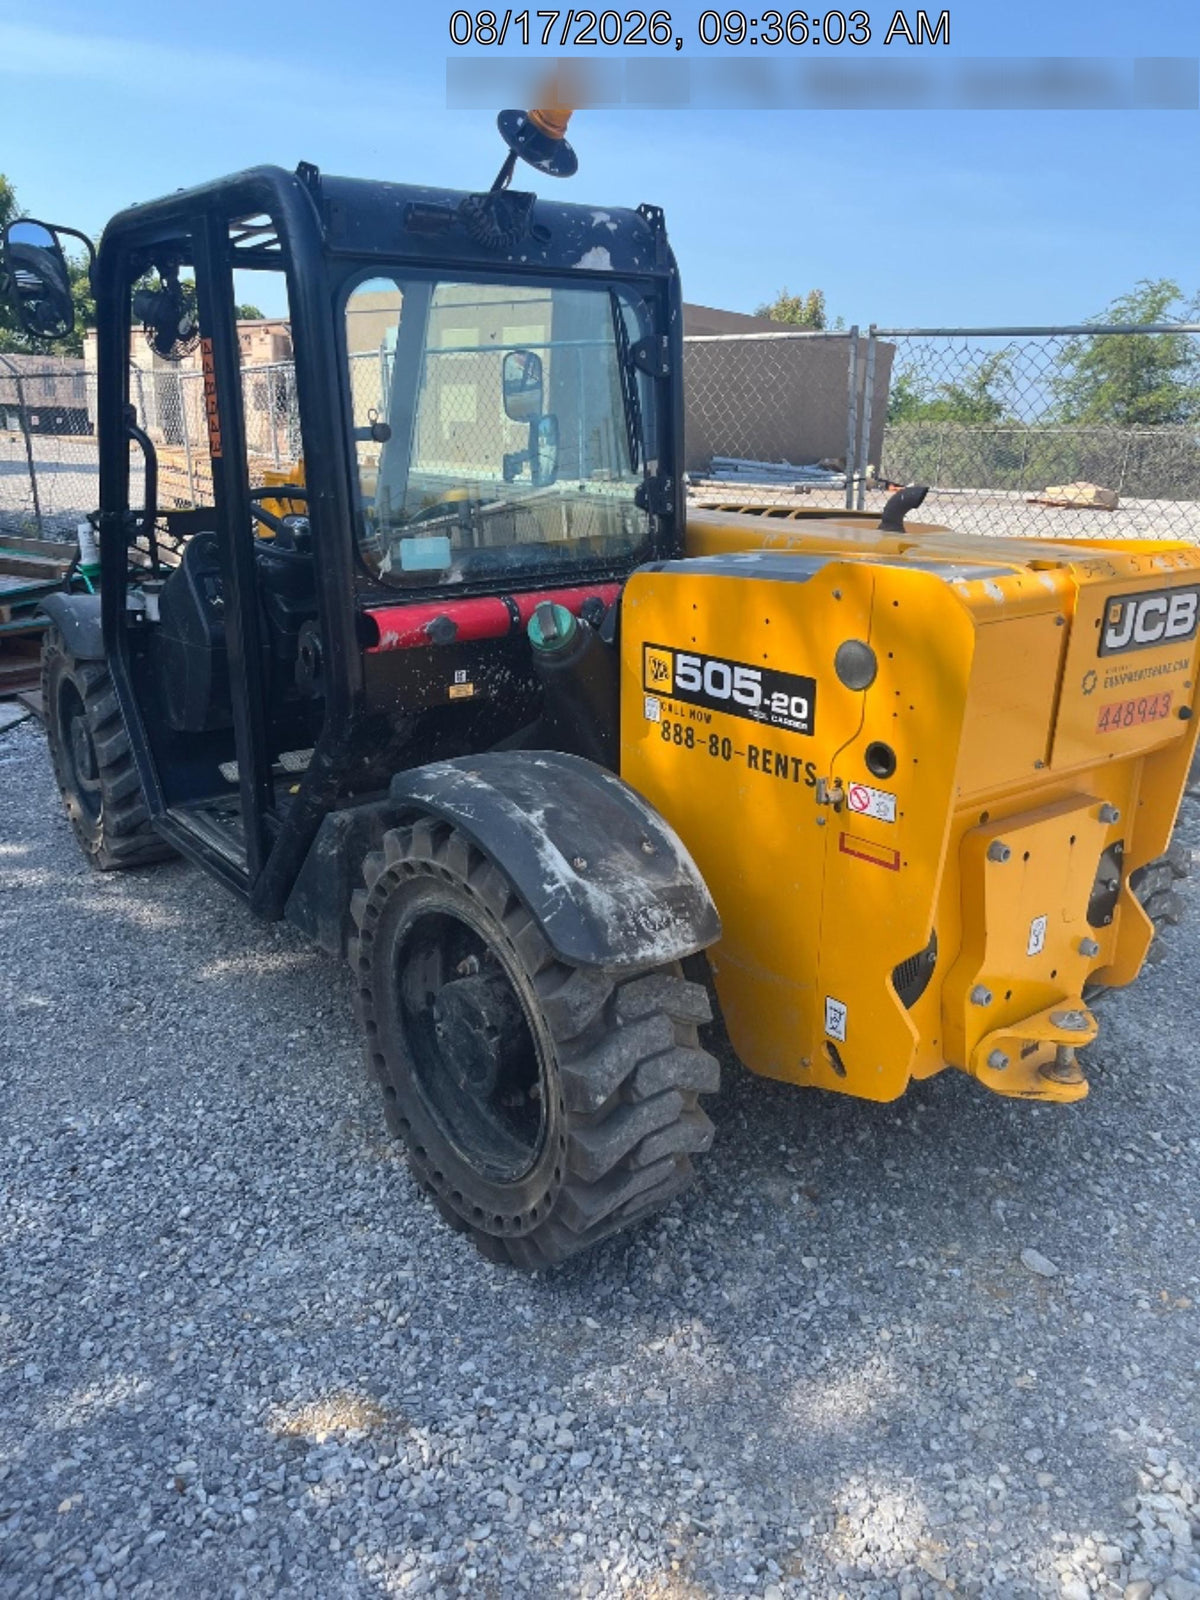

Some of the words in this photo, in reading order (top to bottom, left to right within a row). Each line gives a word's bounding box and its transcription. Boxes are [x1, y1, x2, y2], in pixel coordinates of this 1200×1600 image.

[1105, 593, 1198, 648] JCB
[689, 708, 712, 724] NOW
[1098, 693, 1171, 732] 448943
[661, 719, 818, 788] 888-80-RENTS
